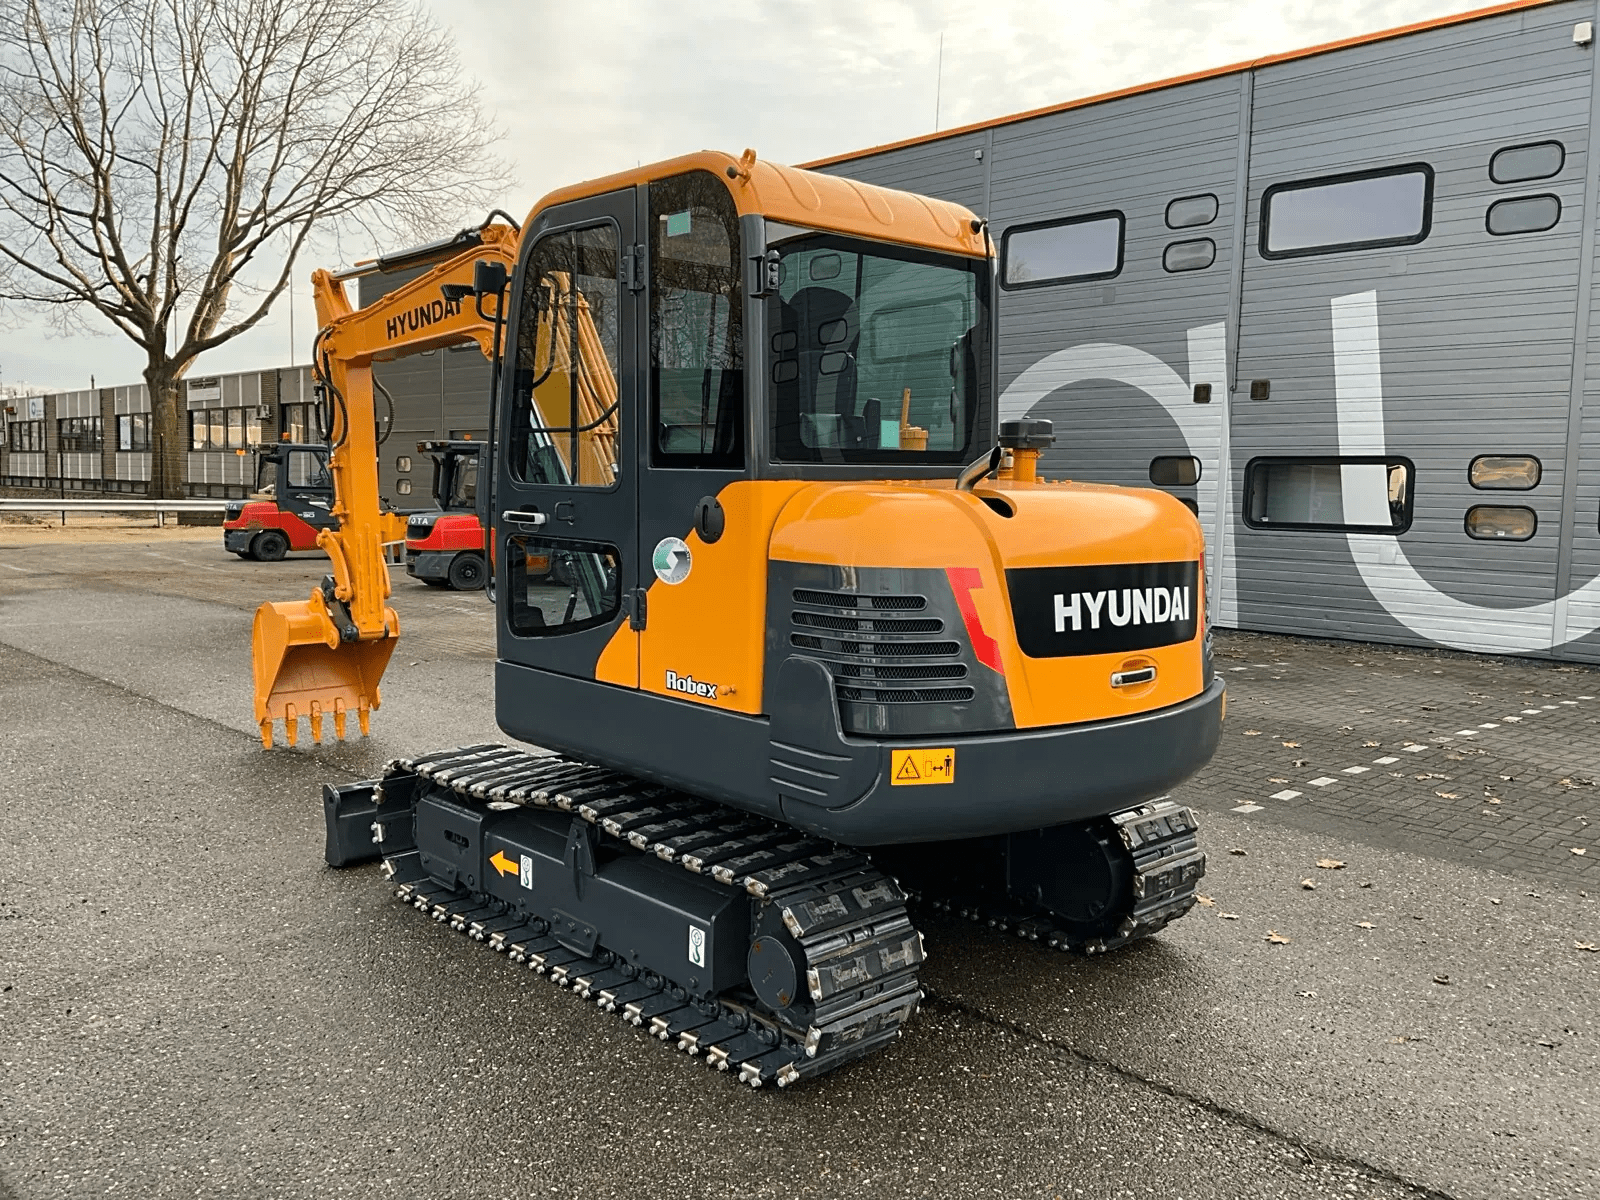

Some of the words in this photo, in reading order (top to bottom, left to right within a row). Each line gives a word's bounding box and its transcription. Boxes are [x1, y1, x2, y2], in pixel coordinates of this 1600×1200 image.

[386, 299, 461, 340] HYUNDAI
[410, 517, 428, 525] OTA
[1053, 586, 1190, 633] HYUNDAI
[665, 669, 718, 700] Robex
